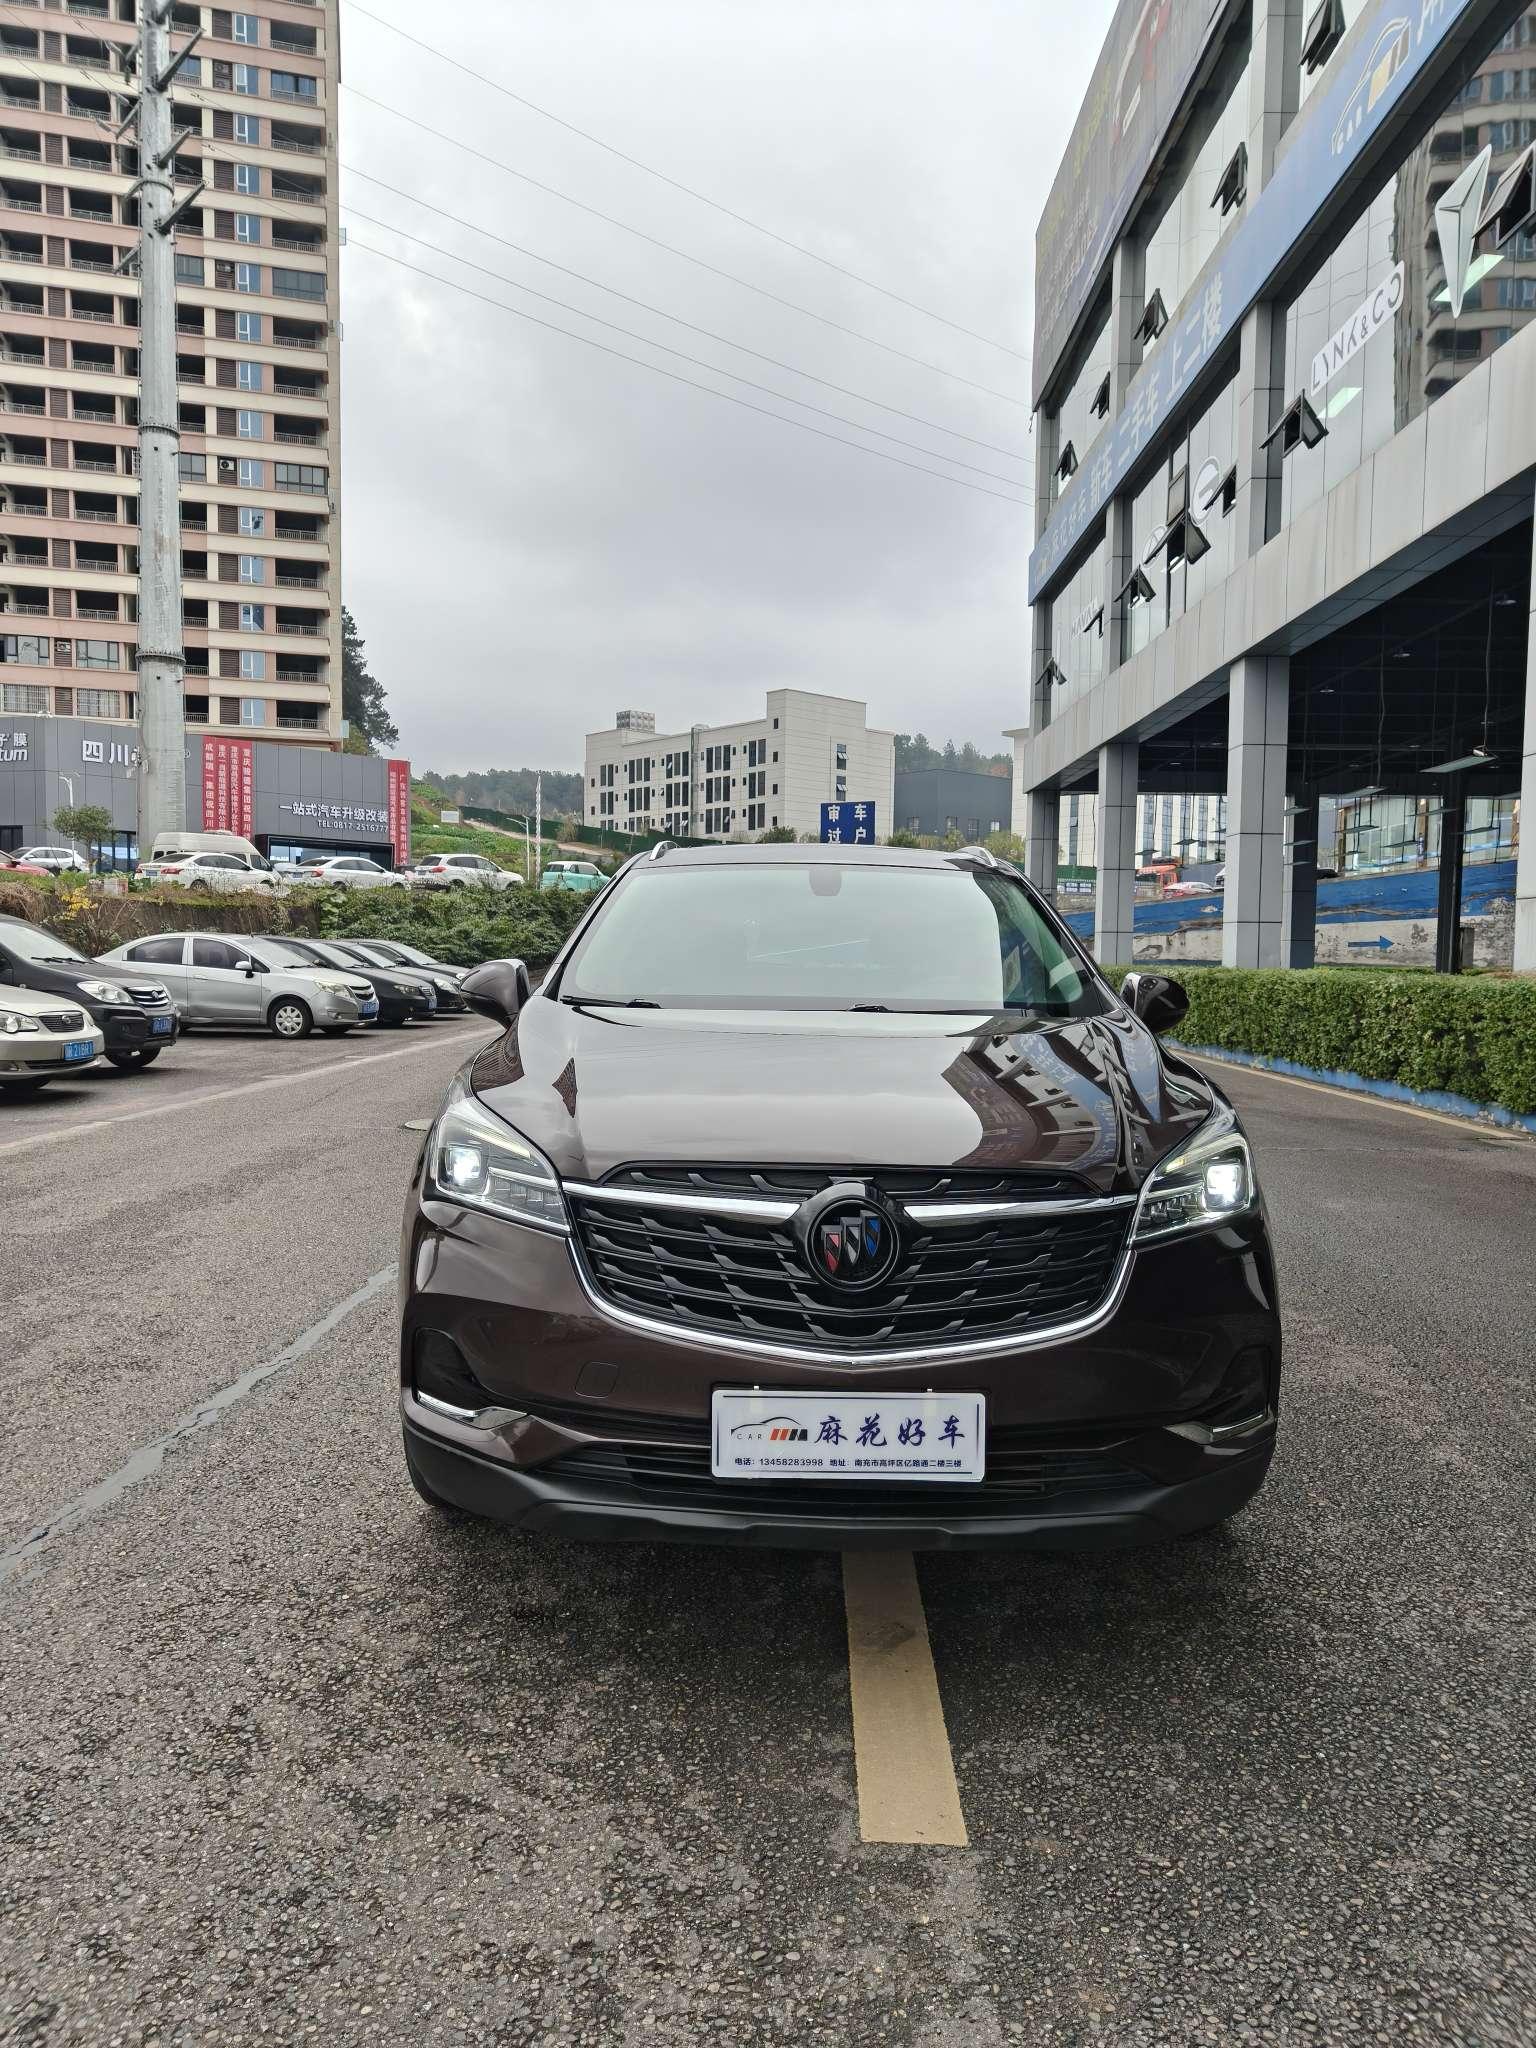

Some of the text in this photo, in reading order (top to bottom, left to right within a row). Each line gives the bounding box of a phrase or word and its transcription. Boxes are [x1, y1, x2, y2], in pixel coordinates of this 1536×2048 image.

[1166, 270, 1223, 404] 上二楼
[279, 801, 388, 823] 一站式汽车升级改装
[814, 1412, 965, 1449] 麻花好车
[760, 1458, 823, 1467] 13458283998
[855, 1459, 962, 1468] 南充市高坪区亿路通二楼三楼
